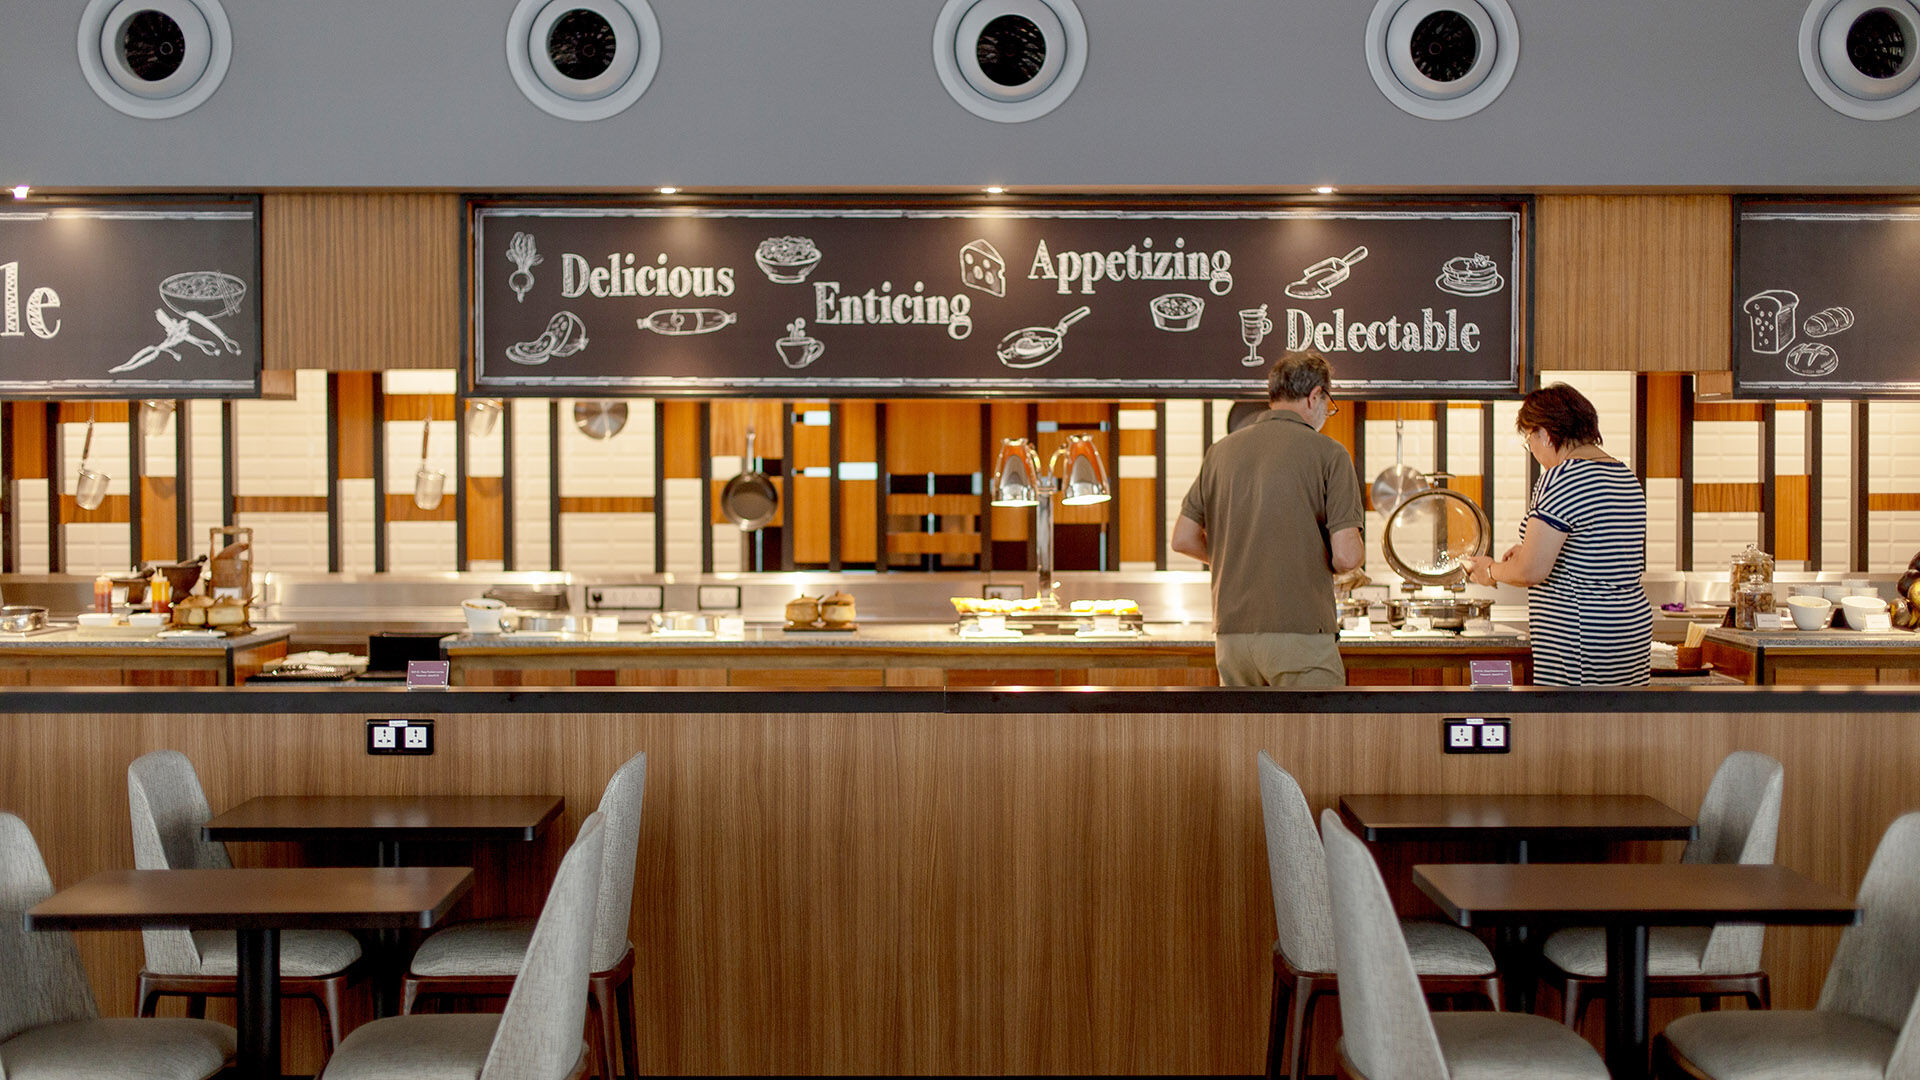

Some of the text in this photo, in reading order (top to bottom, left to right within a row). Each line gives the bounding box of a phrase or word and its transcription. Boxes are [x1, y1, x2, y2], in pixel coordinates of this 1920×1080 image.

[561, 252, 735, 298] Delicious
[1028, 237, 1233, 296] Appetizing
[813, 281, 973, 340] Enticing
[1285, 307, 1481, 353] Delectable
